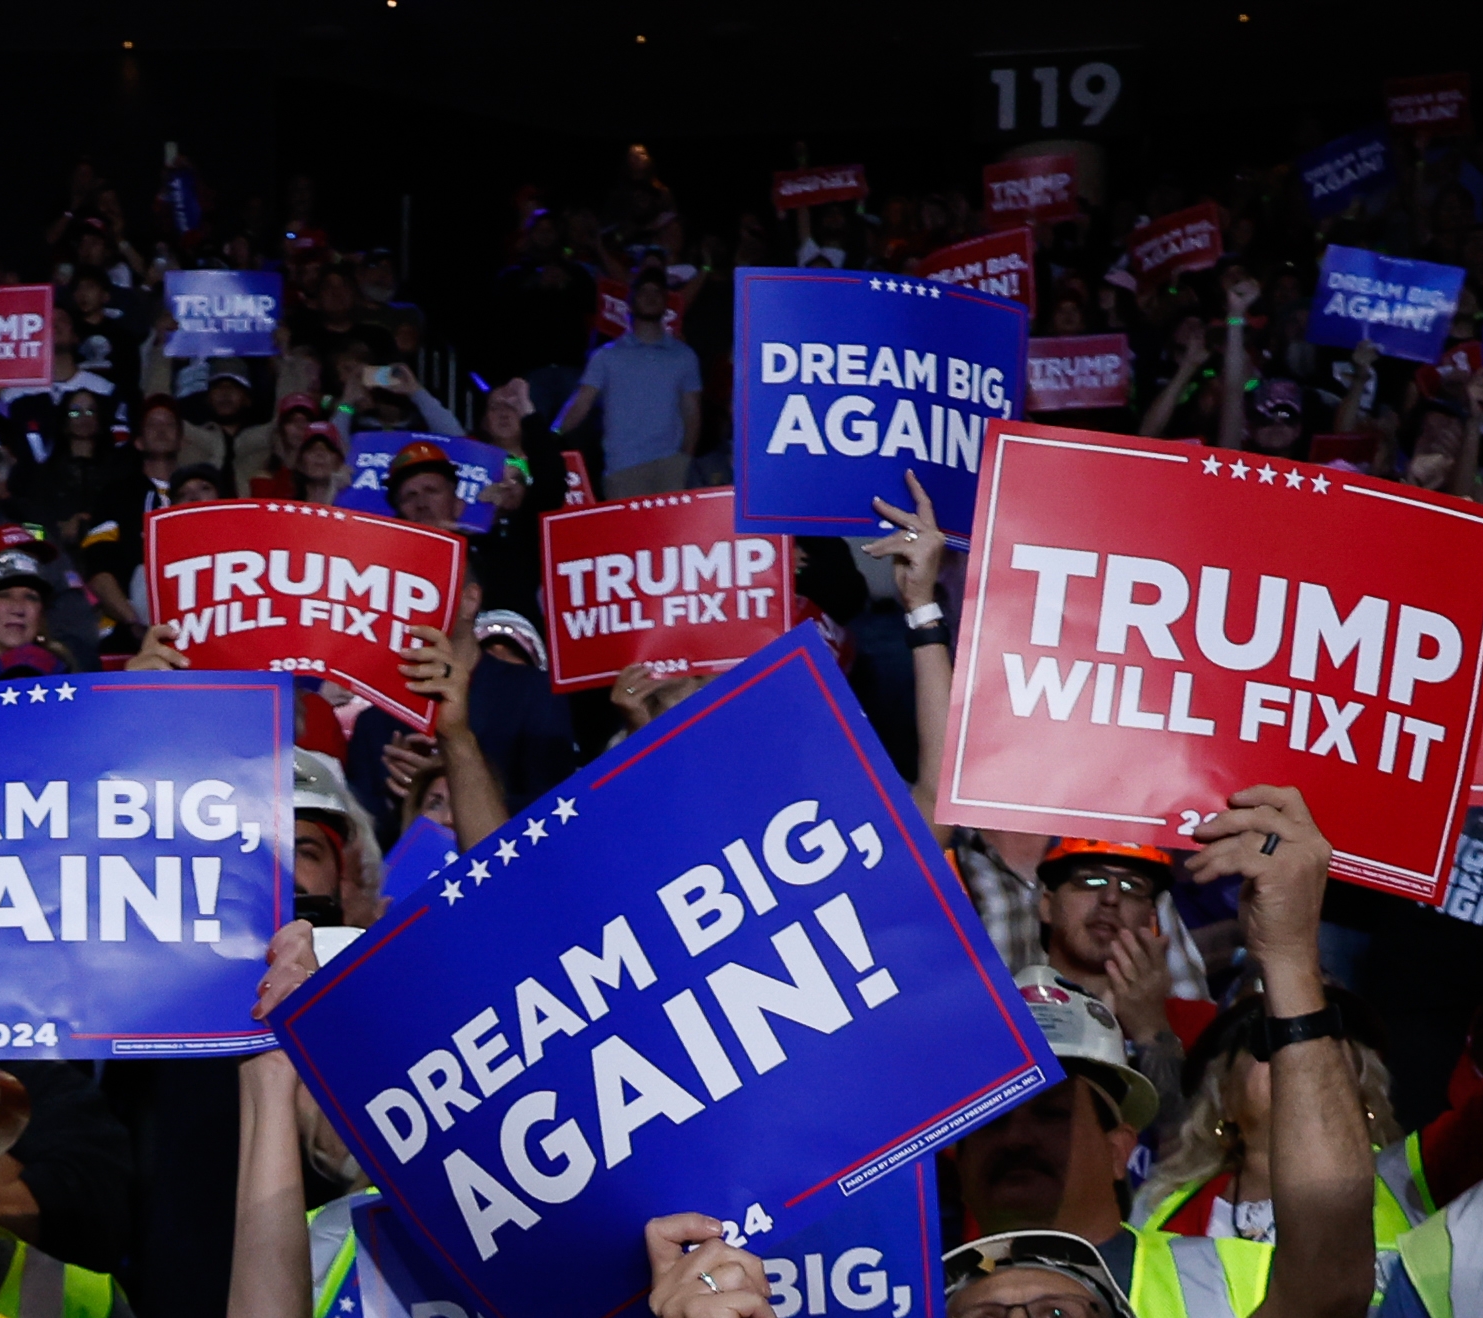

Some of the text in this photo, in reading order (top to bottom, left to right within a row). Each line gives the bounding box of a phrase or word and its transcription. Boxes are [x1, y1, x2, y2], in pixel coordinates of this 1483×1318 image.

[990, 63, 1123, 131] 119
[173, 294, 277, 319] TRUMP
[1322, 291, 1435, 334] AGAIN!
[1326, 272, 1406, 300] DREAM
[19, 340, 42, 358] IT
[1027, 353, 1122, 377] TRUMP
[760, 343, 1013, 419] DREAM BIG,
[164, 549, 441, 621] TRUMP
[555, 537, 776, 609] TRUMP
[168, 599, 379, 652] WILL FIX
[561, 587, 775, 642] WILL FIX IT
[1010, 545, 1464, 707] TRUMP
[269, 657, 327, 674] 2024
[1002, 652, 1446, 783] WILL FIX IT
[96, 778, 262, 854] BIG,
[364, 798, 885, 1165] DREAM BIG,
[440, 892, 901, 1263] AGAIN!
[963, 1092, 1004, 1121] PRESIDENT
